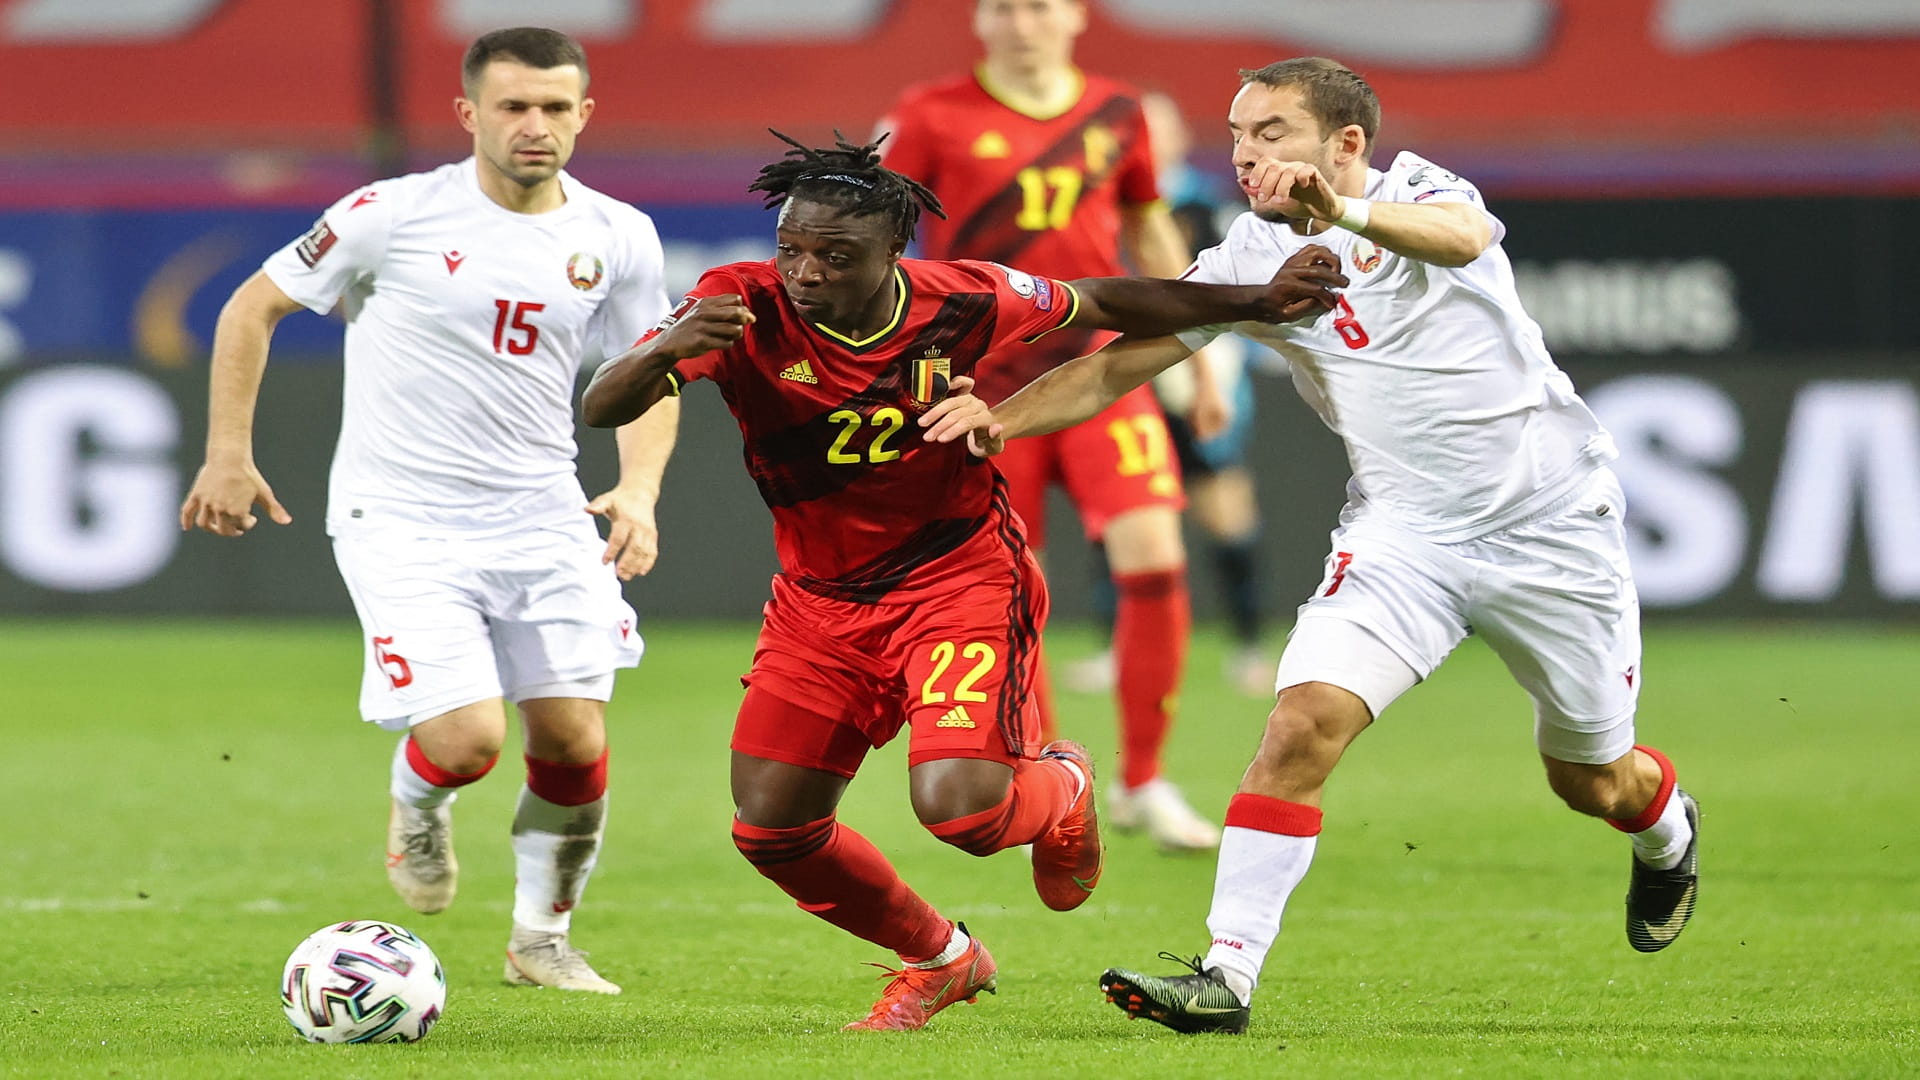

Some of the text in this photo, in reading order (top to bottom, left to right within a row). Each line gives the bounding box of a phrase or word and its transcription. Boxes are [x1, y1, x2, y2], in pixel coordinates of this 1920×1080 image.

[1015, 166, 1082, 230] 17
[493, 299, 545, 355] 15
[1333, 293, 1369, 350] 8
[780, 370, 818, 385] adidas
[828, 408, 903, 464] 22
[1107, 415, 1167, 477] 17
[0, 365, 182, 590] G
[922, 641, 997, 704] 22
